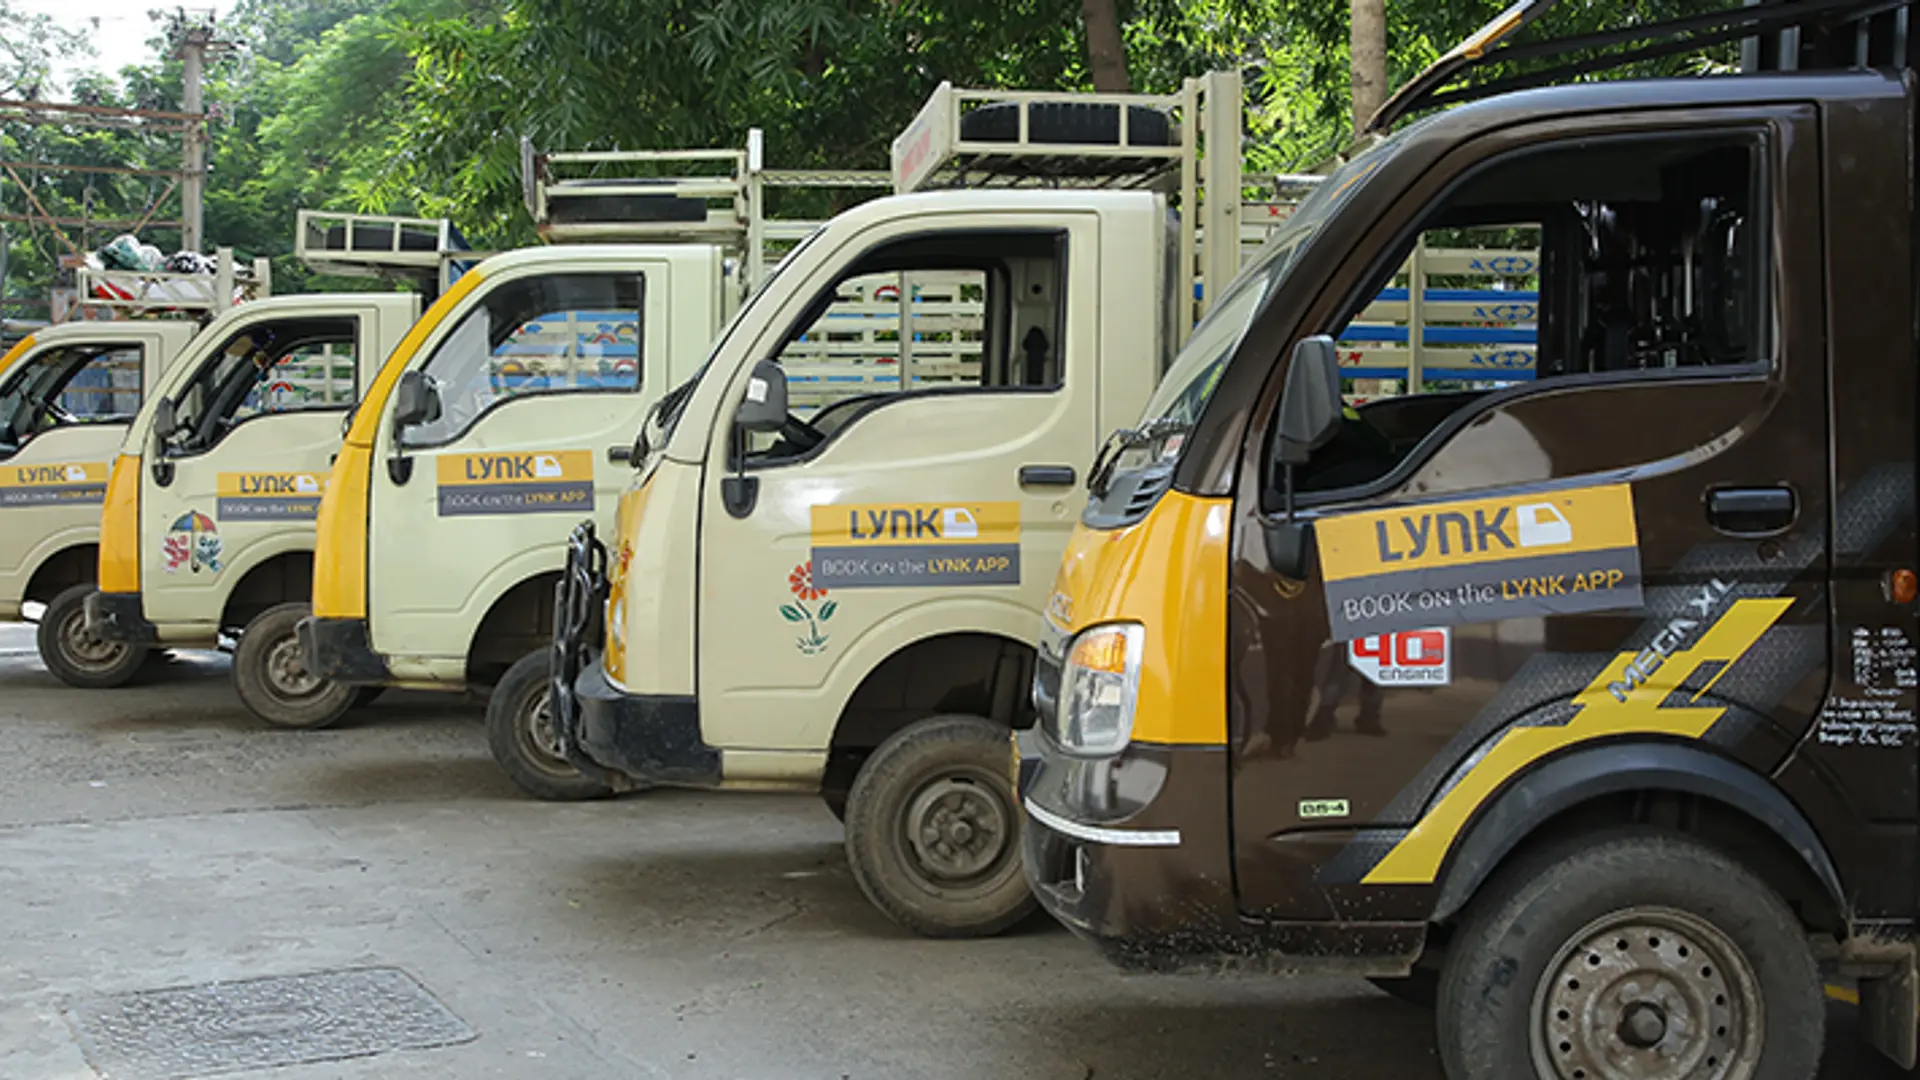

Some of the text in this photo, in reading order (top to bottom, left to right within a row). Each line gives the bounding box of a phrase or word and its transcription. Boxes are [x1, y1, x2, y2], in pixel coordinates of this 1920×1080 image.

[821, 558, 870, 577] BOOK
[928, 558, 971, 574] LYNK
[975, 557, 1010, 573] APP
[1343, 593, 1413, 622] BOOK
[1456, 583, 1496, 605] the
[1502, 575, 1566, 600] LYNK
[1573, 568, 1624, 593] APP
[1607, 578, 1738, 703] MEGA XL
